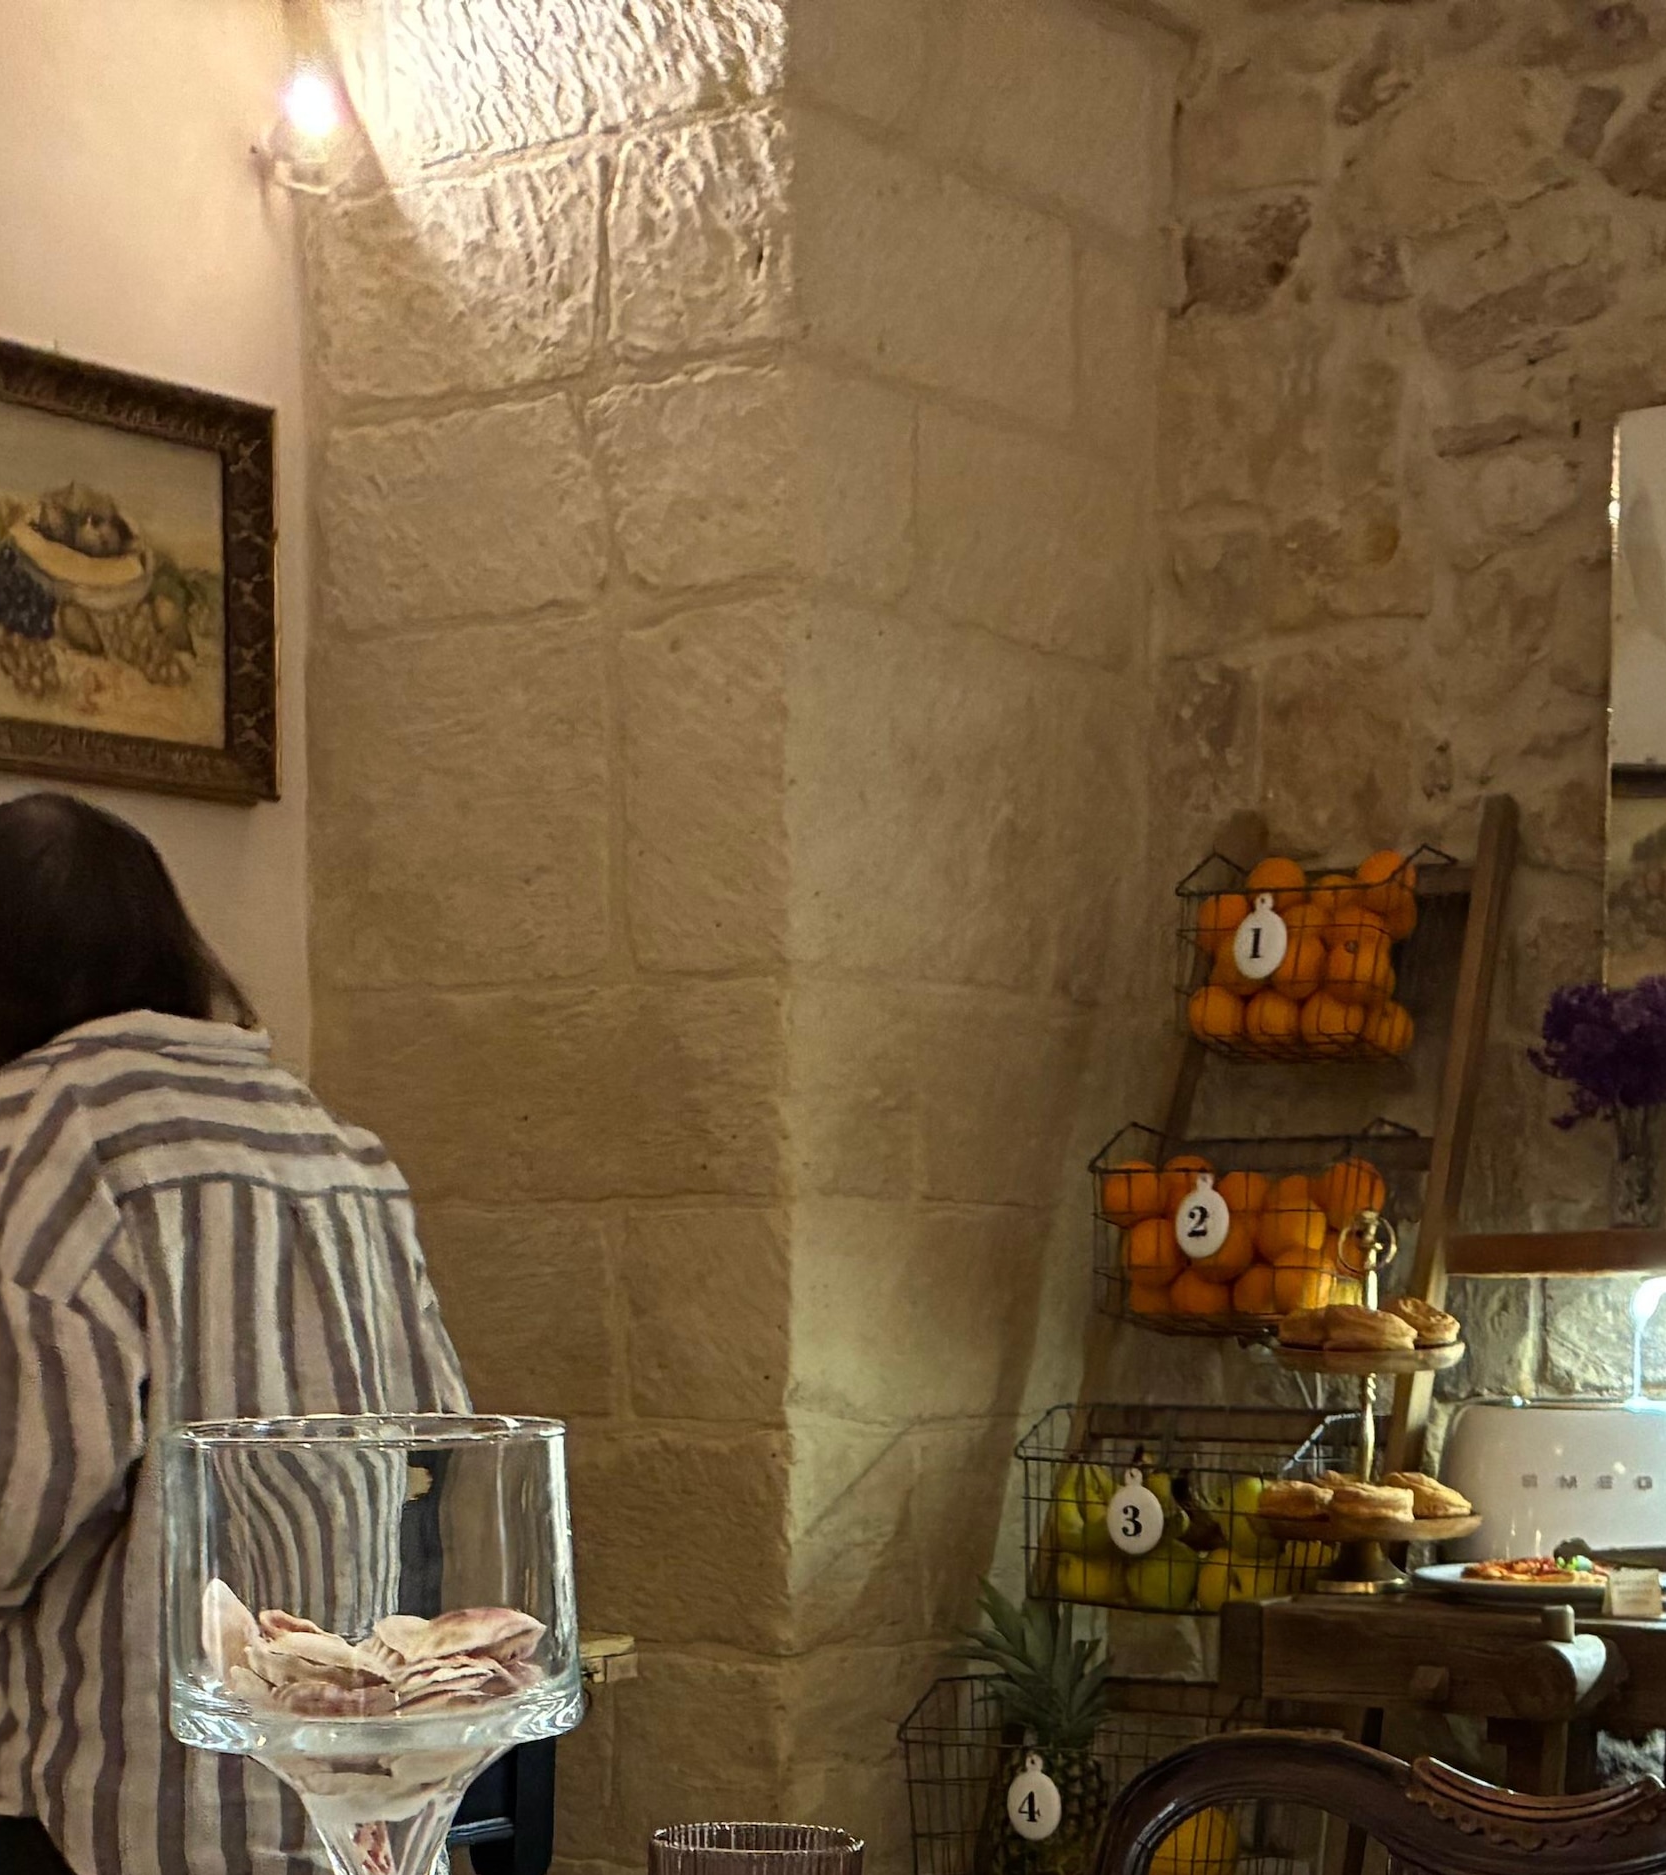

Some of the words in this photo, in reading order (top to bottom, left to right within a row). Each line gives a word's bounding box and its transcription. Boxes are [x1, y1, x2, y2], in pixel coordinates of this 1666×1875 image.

[1249, 927, 1262, 959] 1
[1187, 1205, 1210, 1239] 2
[1521, 1473, 1653, 1491] SMEG
[1121, 1504, 1143, 1538] 3
[1017, 1790, 1041, 1823] 4
